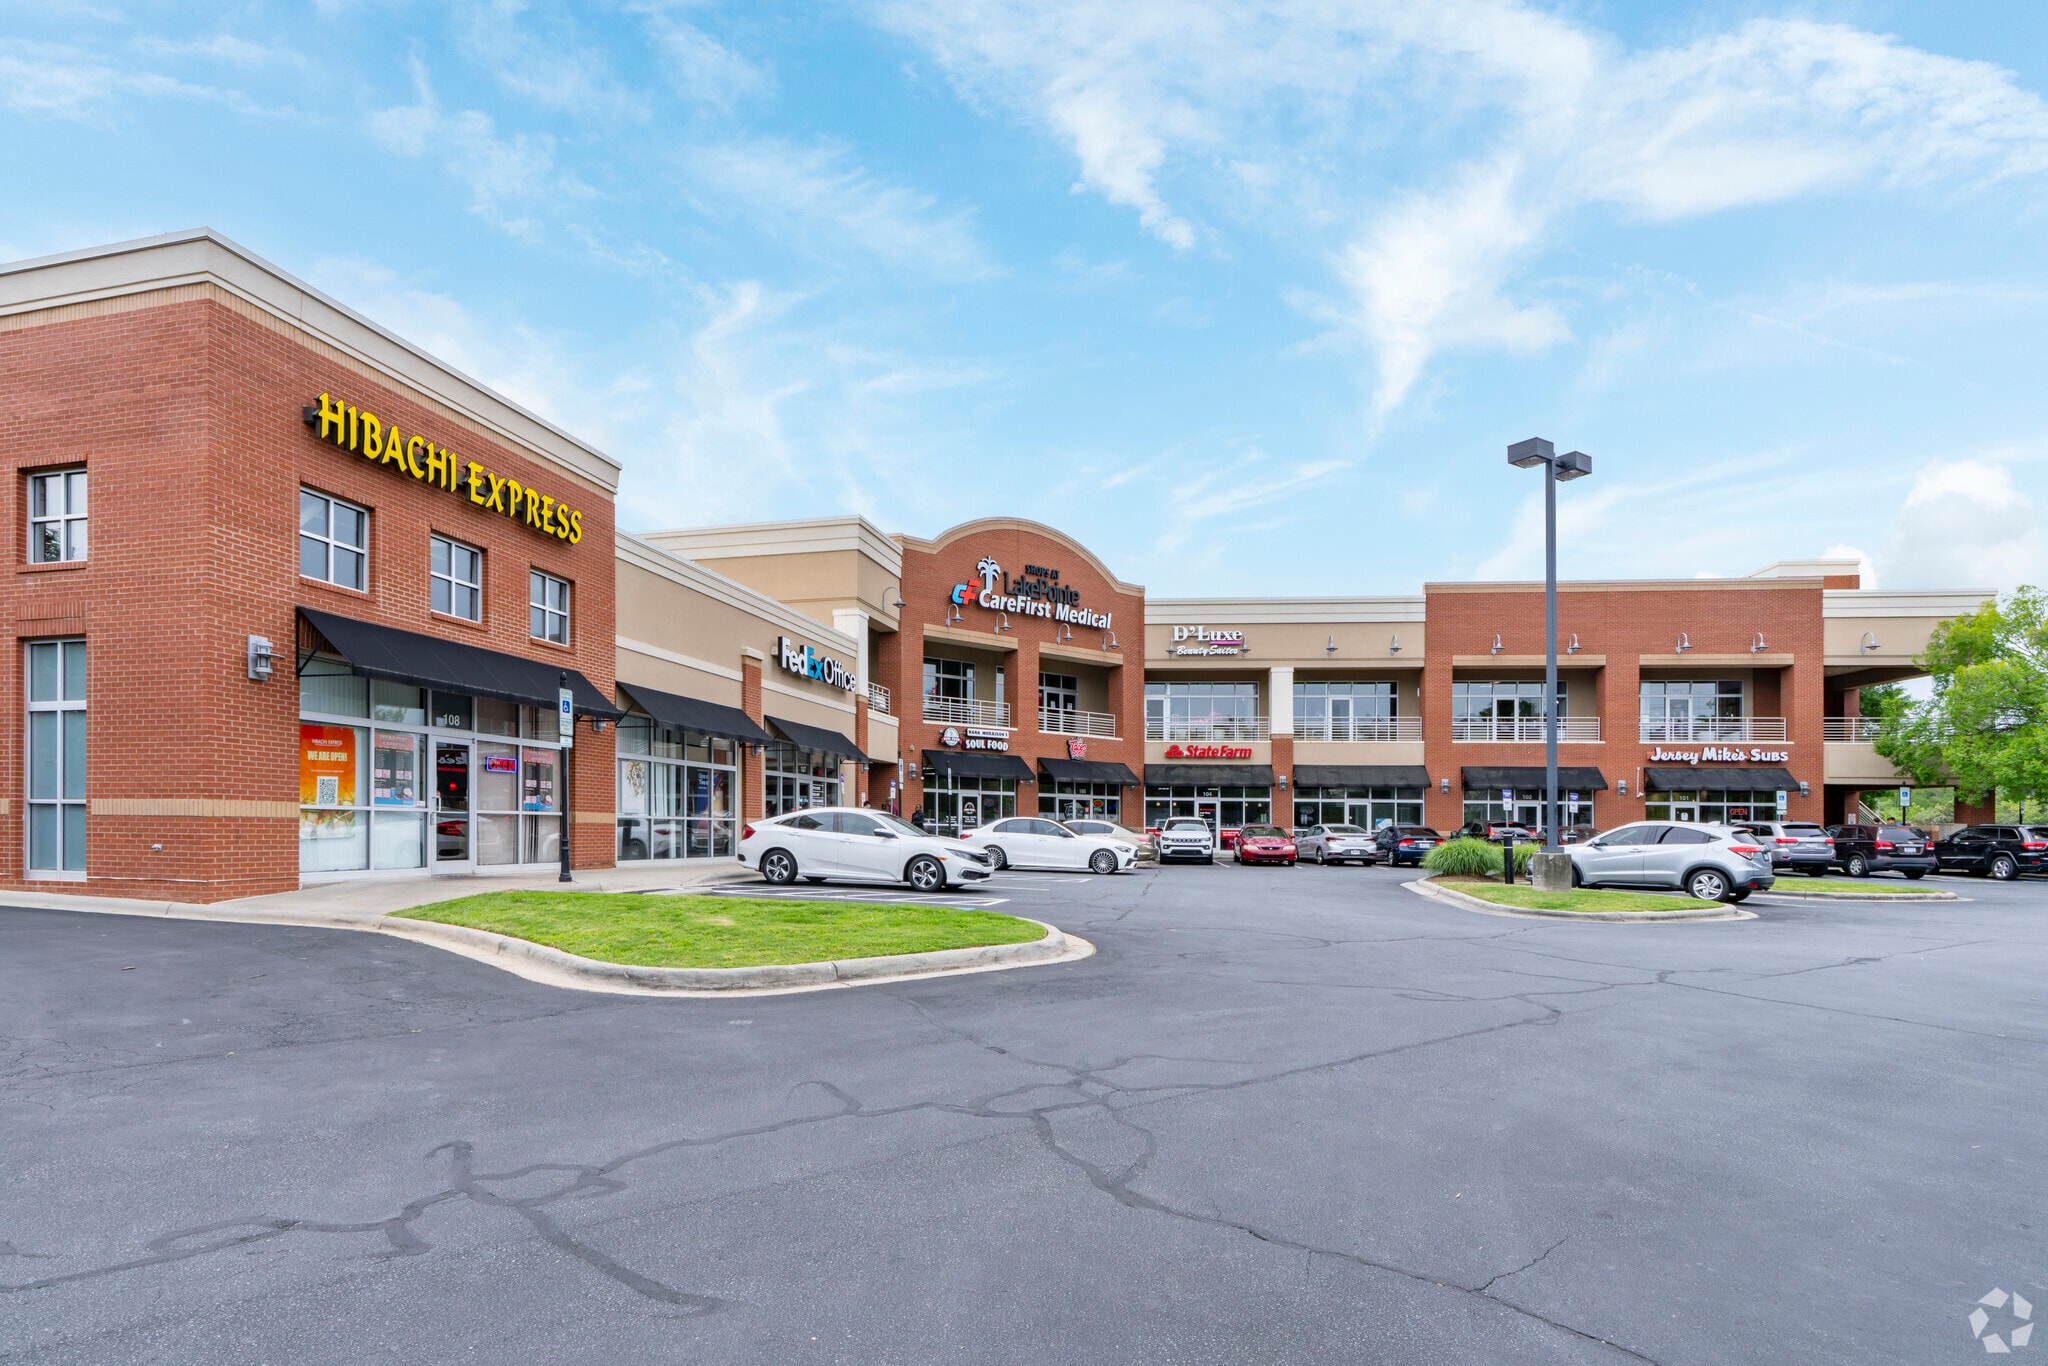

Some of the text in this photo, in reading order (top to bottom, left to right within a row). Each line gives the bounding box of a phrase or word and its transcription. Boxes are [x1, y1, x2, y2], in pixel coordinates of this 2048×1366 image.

[318, 392, 583, 545] HIBACHI EXPRESS
[1025, 564, 1060, 580] SHOPS AT
[1004, 571, 1080, 607] LakePointe
[978, 589, 1113, 630] CareFirst Medical
[1173, 625, 1243, 642] D'Luxe
[1176, 645, 1239, 657] Beauty Suites
[780, 636, 857, 693] FedEx Office
[443, 713, 460, 727] 108
[965, 738, 986, 749] SOUL
[987, 739, 1009, 752] FOOD
[307, 750, 318, 761] WE
[319, 751, 330, 761] ARE
[1650, 747, 1699, 765] Jersey
[1702, 747, 1748, 761] Mike's
[488, 758, 516, 772] OPEN
[1729, 807, 1748, 816] OPEN
